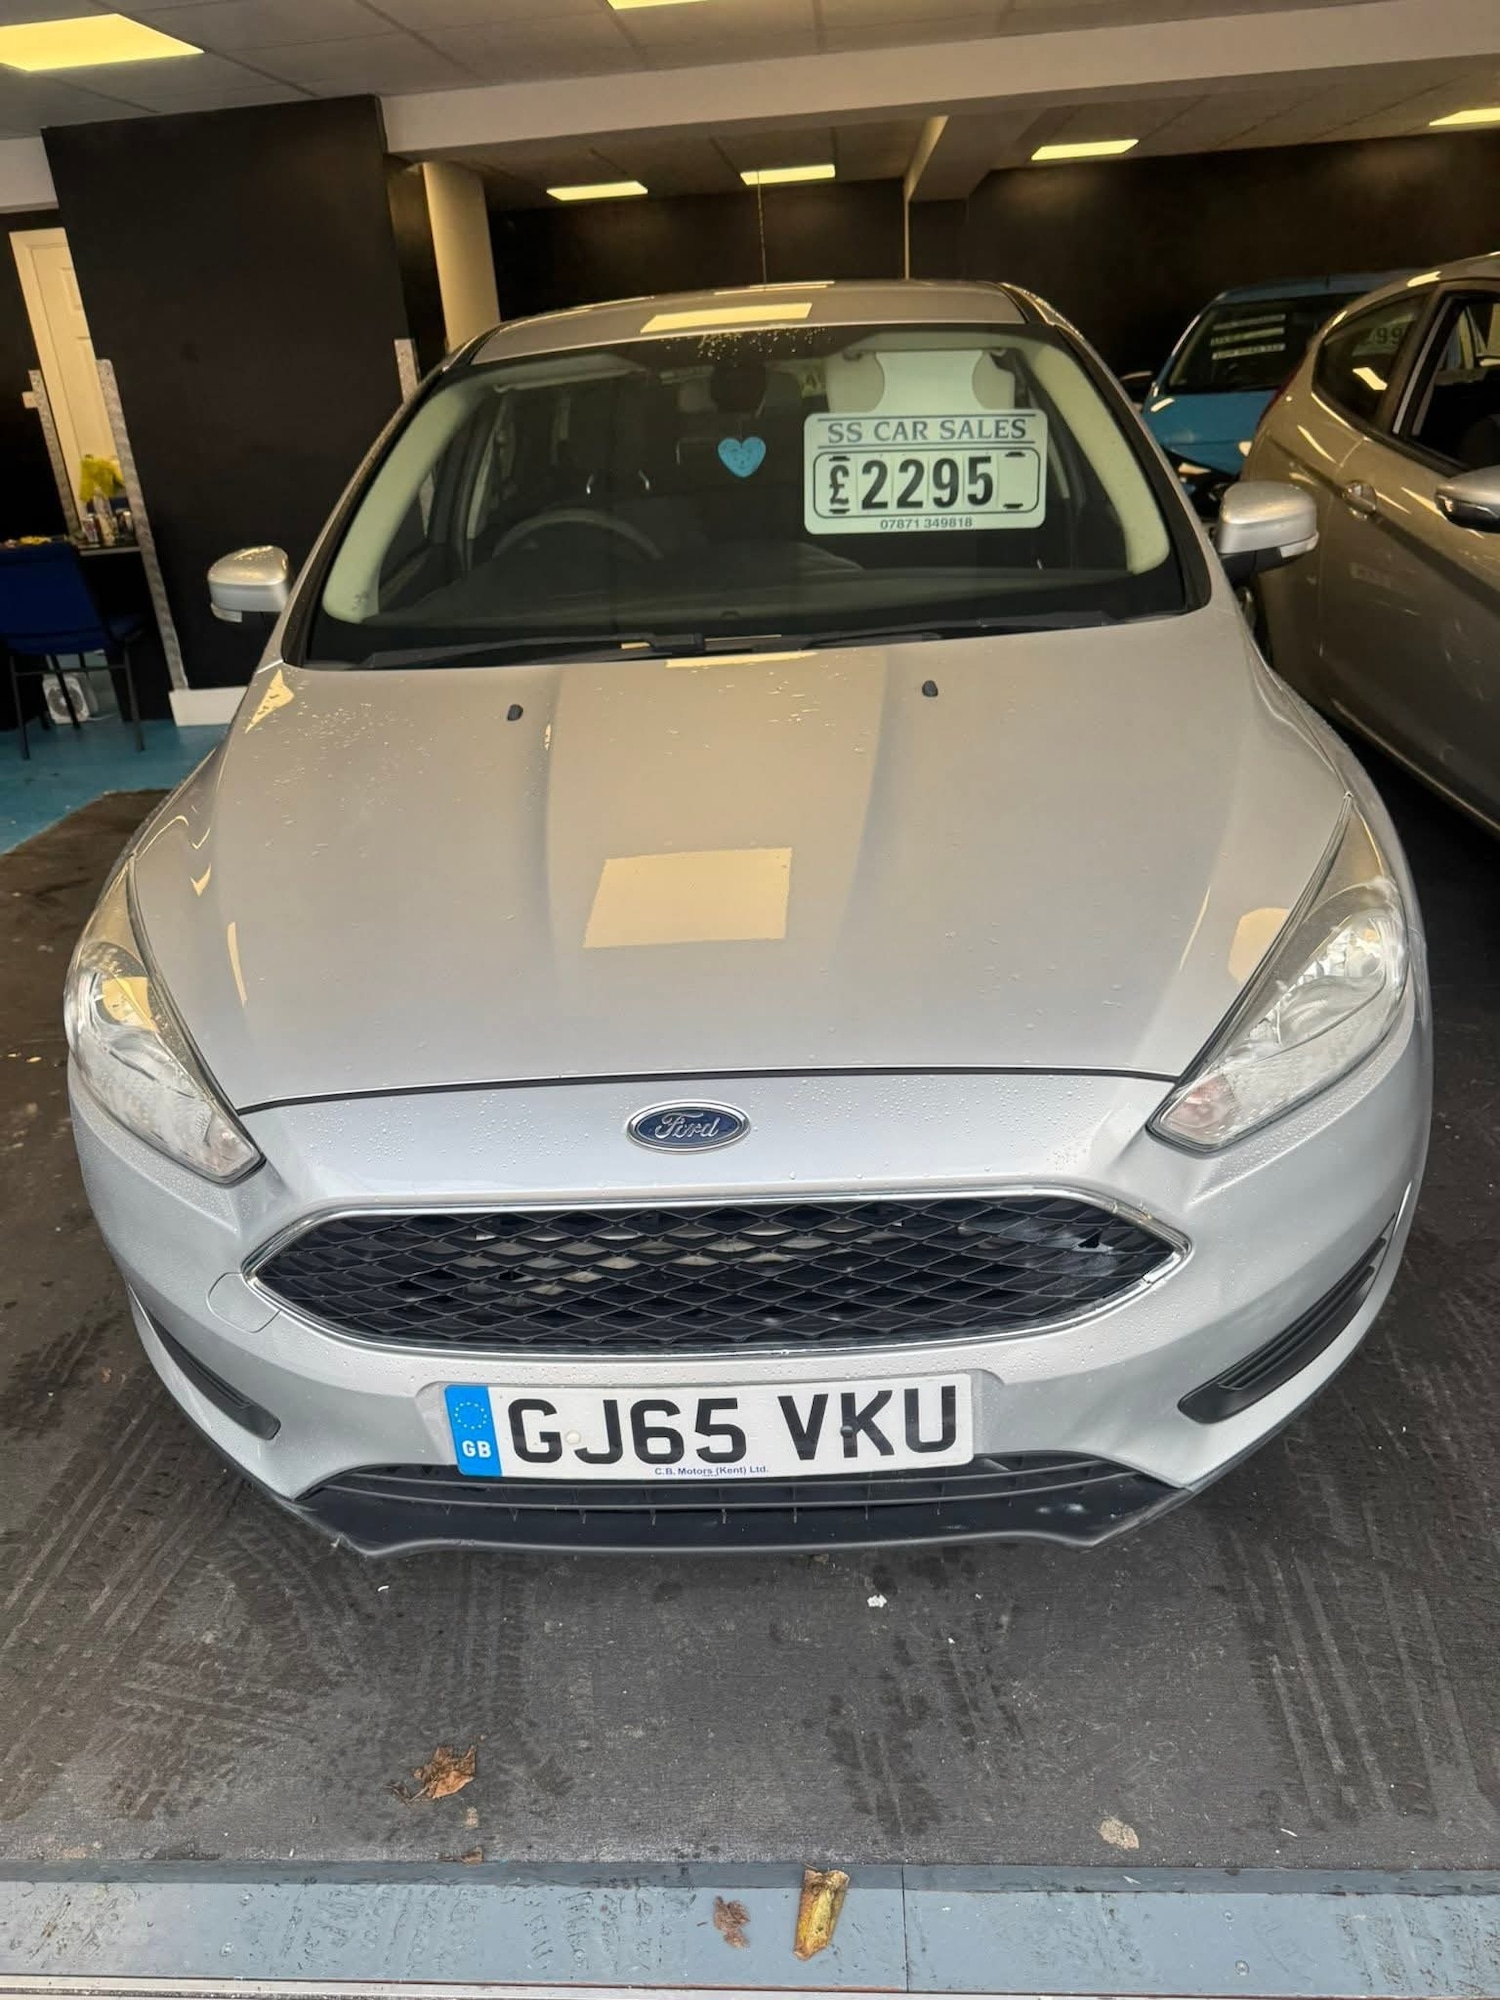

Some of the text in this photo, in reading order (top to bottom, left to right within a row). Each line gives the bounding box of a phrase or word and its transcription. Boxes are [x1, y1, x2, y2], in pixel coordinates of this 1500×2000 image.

[828, 418, 1027, 444] SS CAR SALES
[829, 455, 994, 510] £2295
[880, 516, 973, 530] 07871 349818
[654, 1112, 721, 1139] Ford
[507, 1385, 957, 1464] GJ65 VKU
[461, 1439, 492, 1458] GB
[654, 1467, 676, 1476] C.B.
[677, 1467, 713, 1476] Motors
[716, 1465, 747, 1476] (Kent)
[749, 1465, 769, 1474] Ltd.
